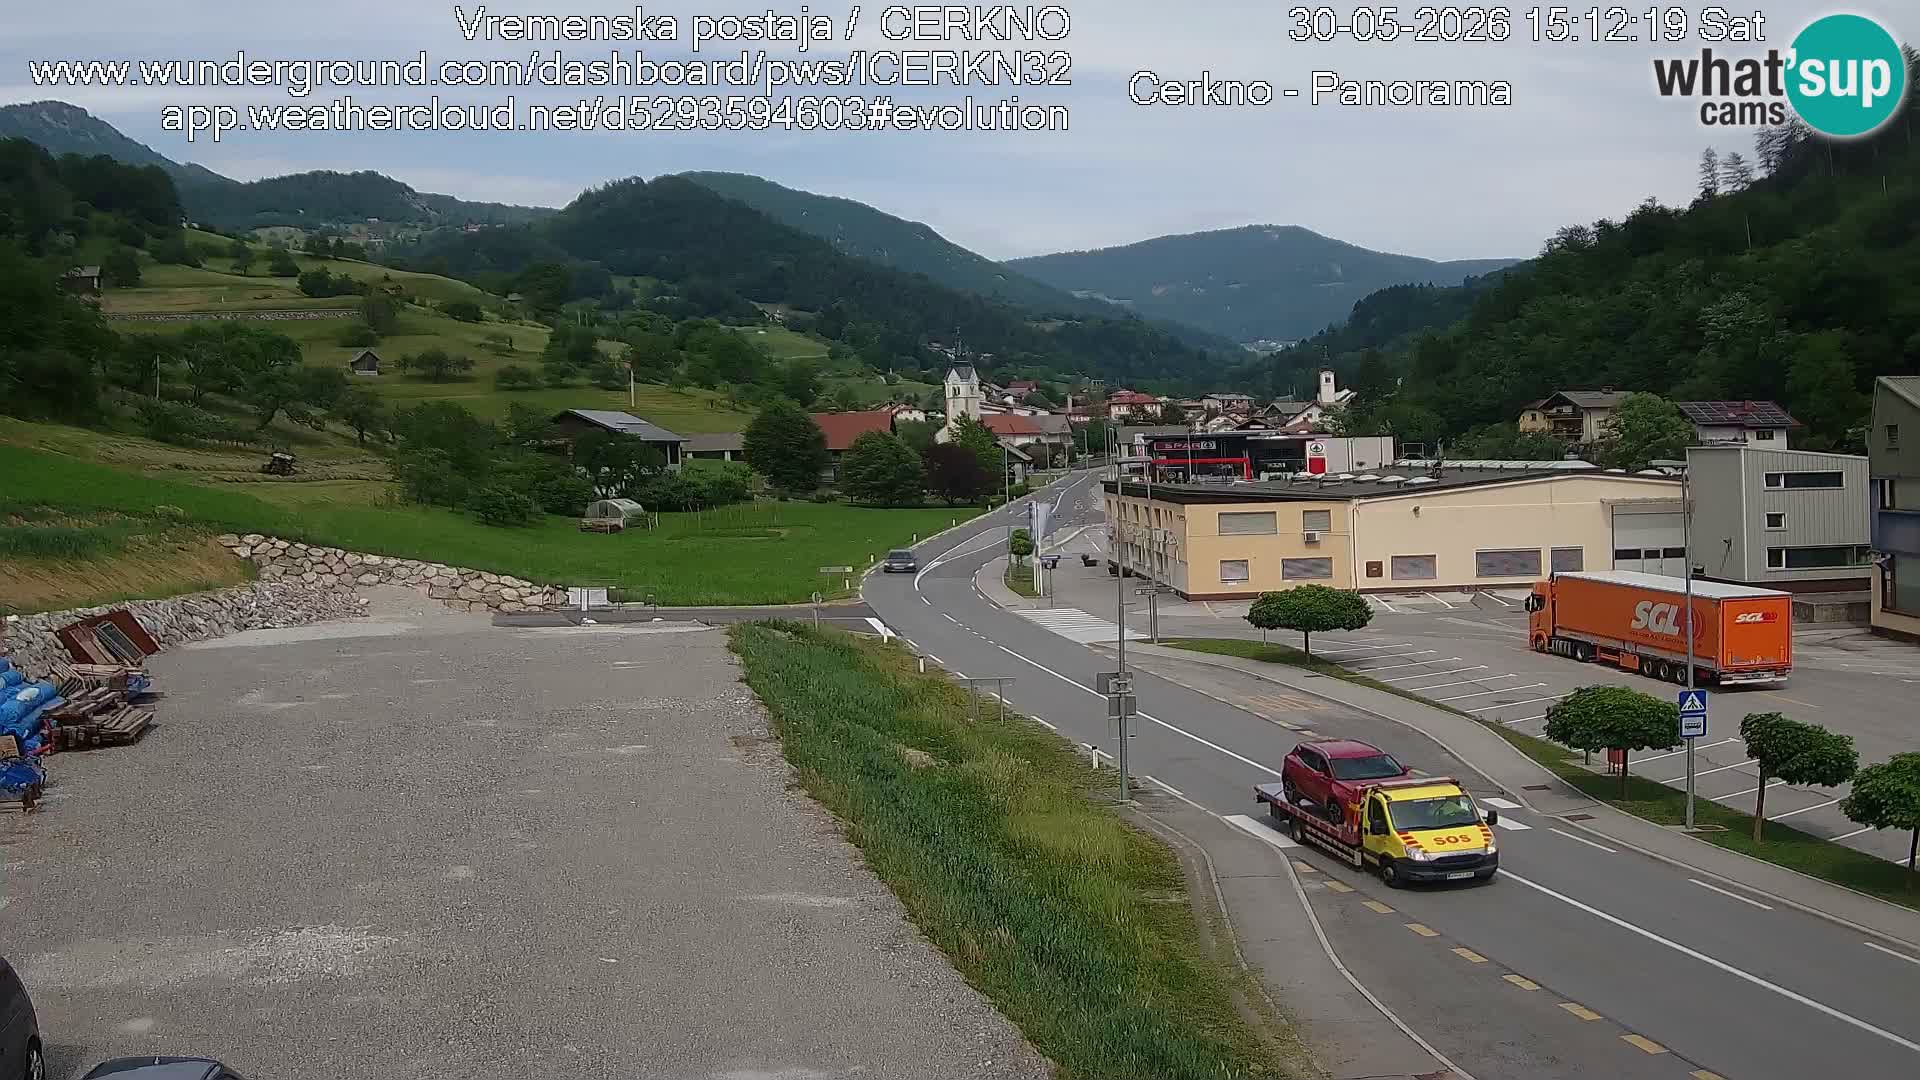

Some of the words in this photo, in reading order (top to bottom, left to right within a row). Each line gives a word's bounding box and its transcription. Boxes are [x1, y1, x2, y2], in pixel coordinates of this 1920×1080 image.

[1164, 442, 1201, 450] SPAR
[1631, 600, 1680, 636] SGL
[1735, 612, 1764, 624] SGL
[1433, 834, 1472, 845] SOS
